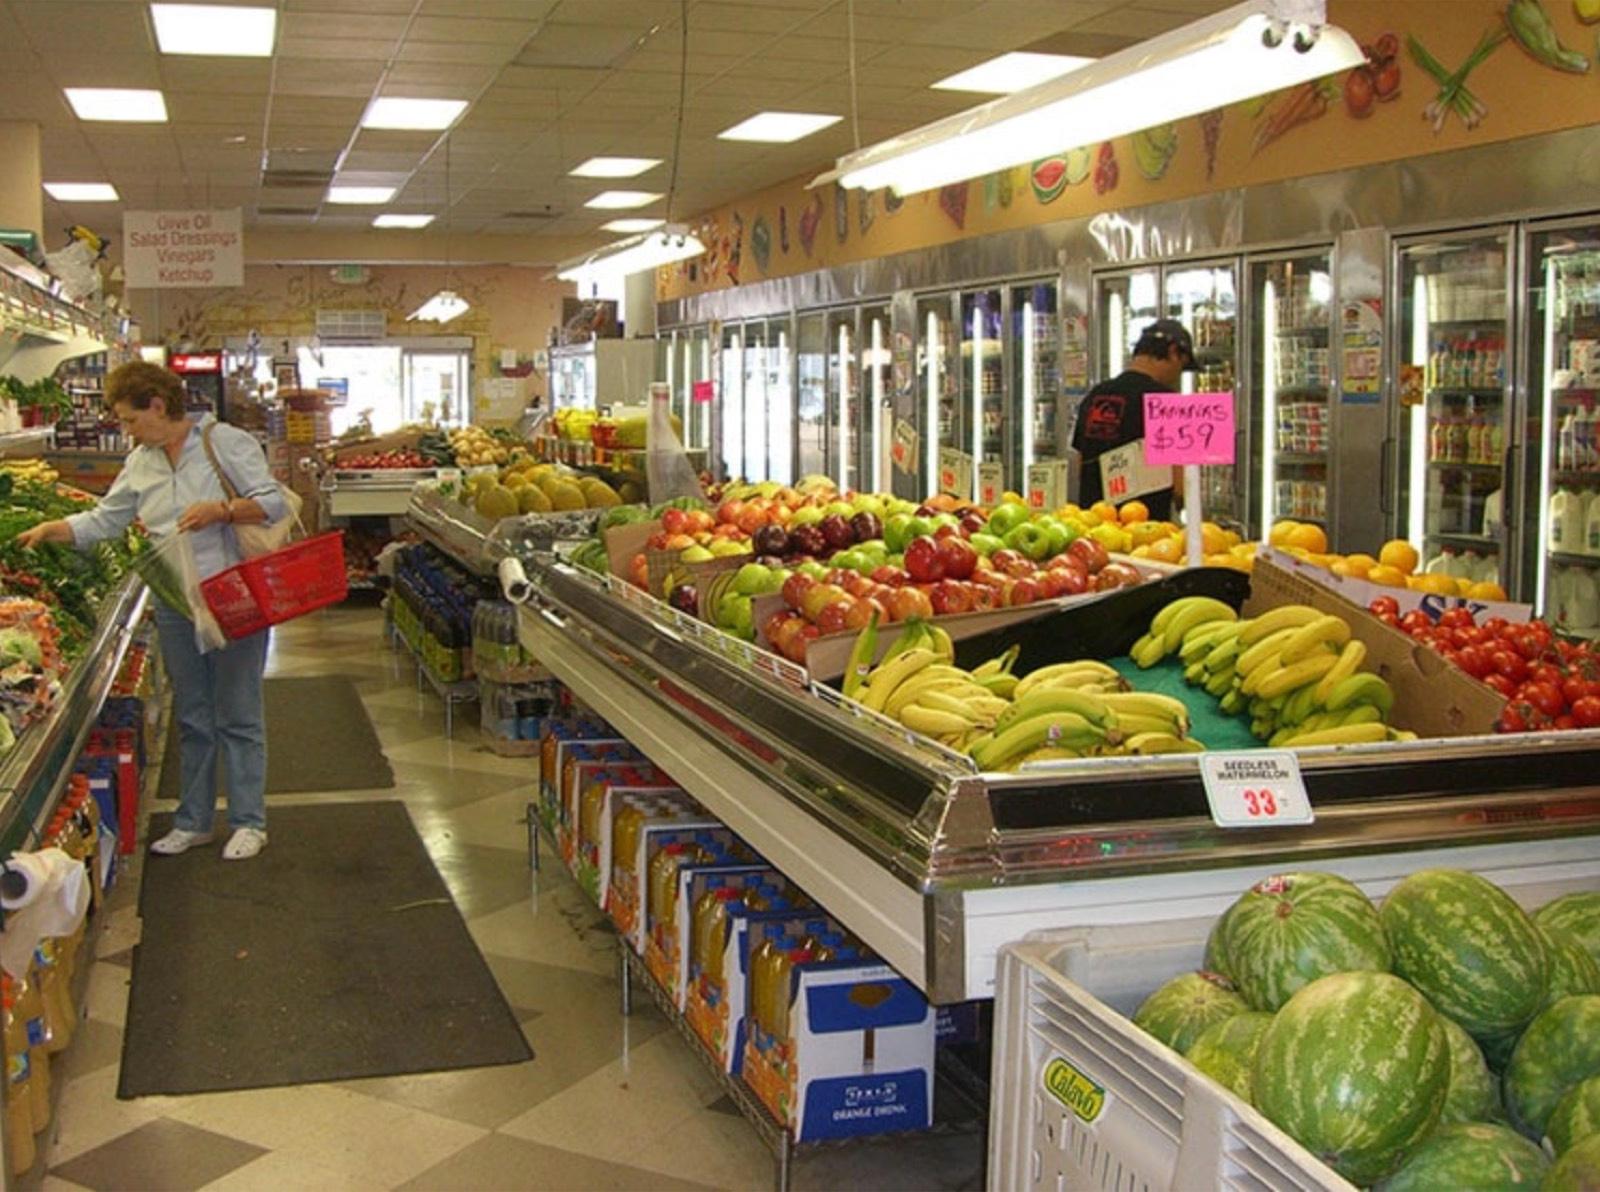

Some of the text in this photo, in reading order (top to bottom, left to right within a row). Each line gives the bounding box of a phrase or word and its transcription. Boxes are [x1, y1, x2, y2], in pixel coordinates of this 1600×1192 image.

[193, 213, 212, 230] Oil
[130, 231, 237, 248] Salad Dressings
[156, 248, 215, 264] Vinegars
[158, 268, 214, 283] Ketchup
[1150, 422, 1215, 453] $59
[1224, 759, 1278, 771] SEEDLESS
[1217, 769, 1290, 781] WATERMELON
[1244, 788, 1278, 817] 33
[832, 1103, 907, 1122] ORANGE DRINK
